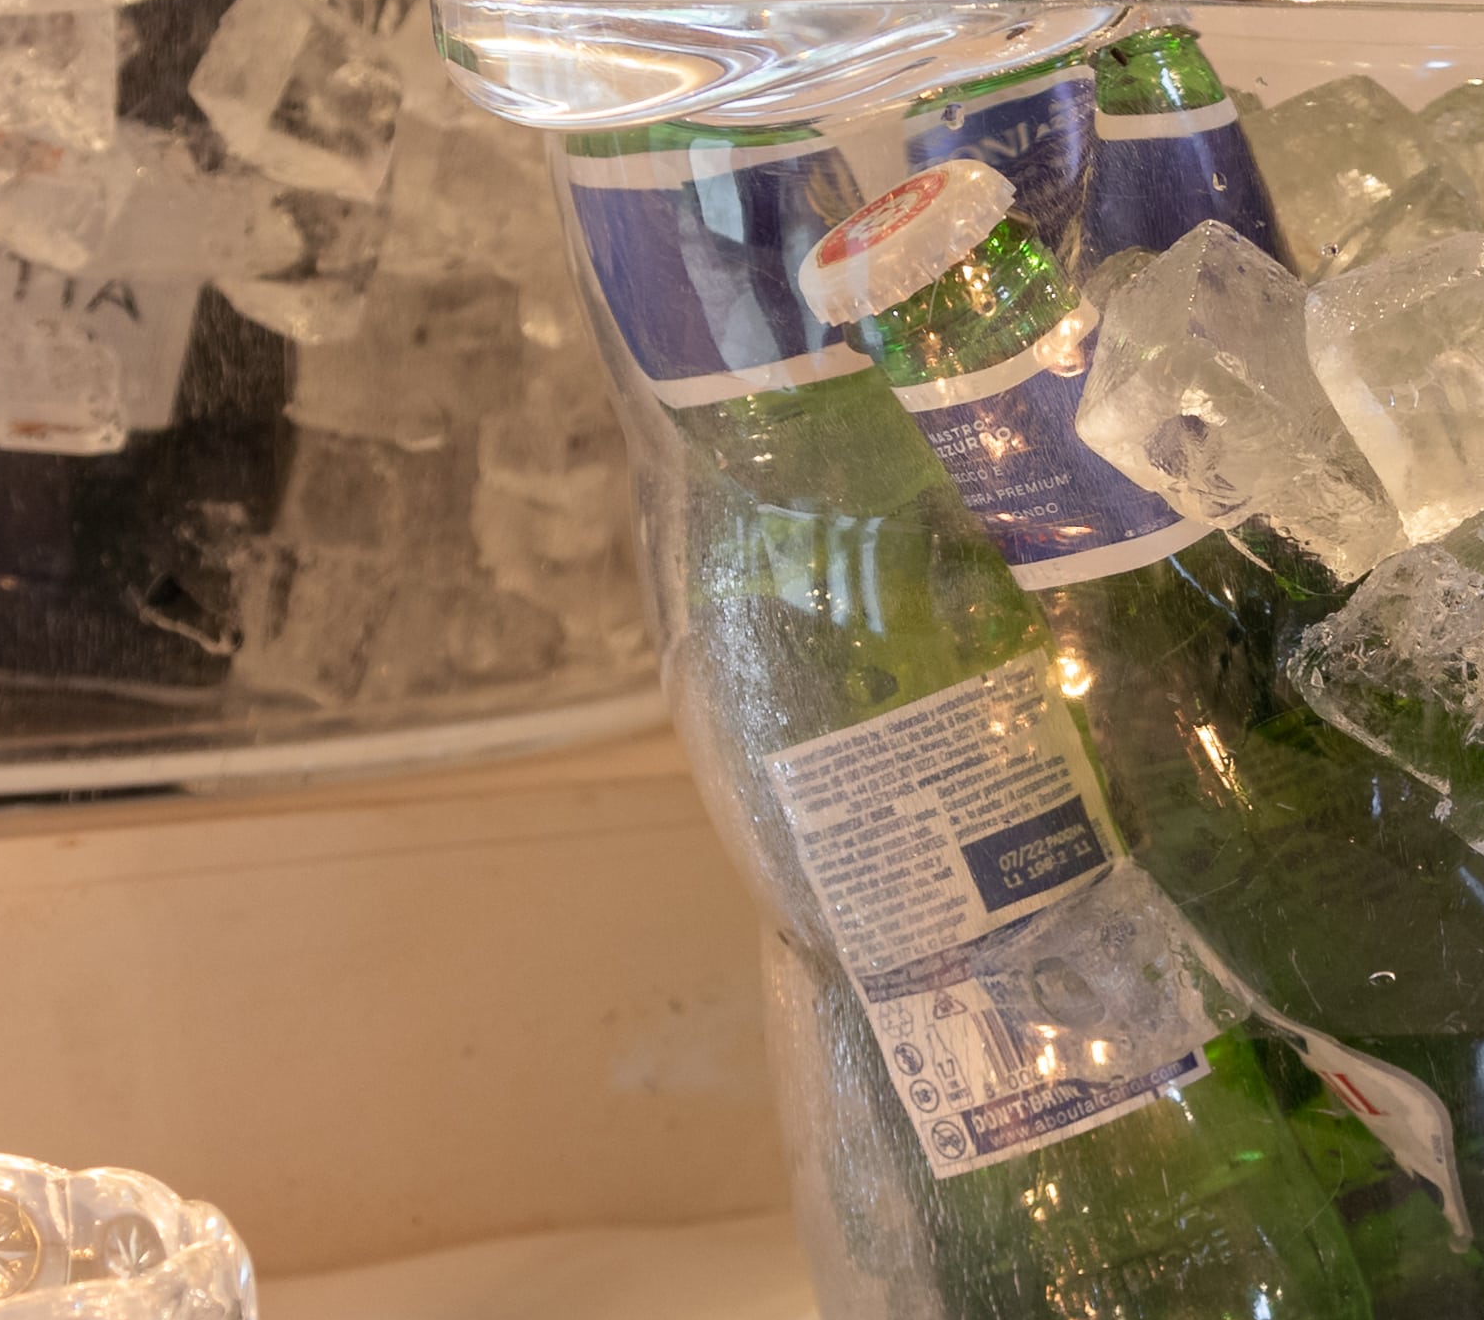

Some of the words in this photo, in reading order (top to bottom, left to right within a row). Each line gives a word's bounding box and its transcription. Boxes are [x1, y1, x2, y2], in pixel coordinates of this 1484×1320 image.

[996, 474, 1071, 501] PREMIUM
[998, 839, 1045, 873] 07/22
[972, 1101, 1028, 1133] DON'T
